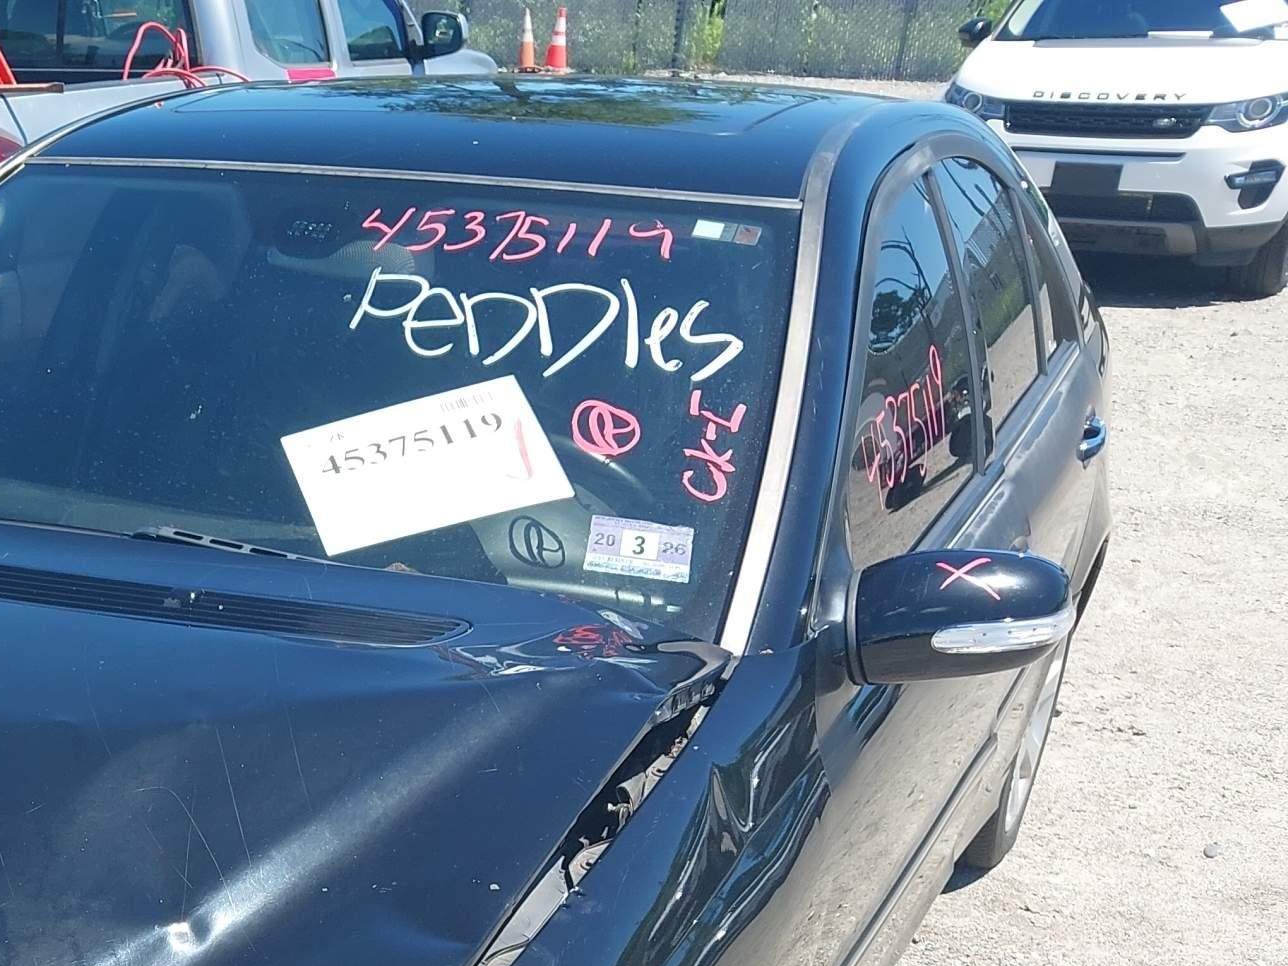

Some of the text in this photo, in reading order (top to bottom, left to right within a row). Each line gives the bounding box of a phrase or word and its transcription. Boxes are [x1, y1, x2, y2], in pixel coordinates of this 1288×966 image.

[1032, 90, 1186, 101] DISCOVERY
[362, 207, 674, 261] 45375119
[321, 412, 503, 474] 45375119
[594, 532, 688, 557] 20 3 26
